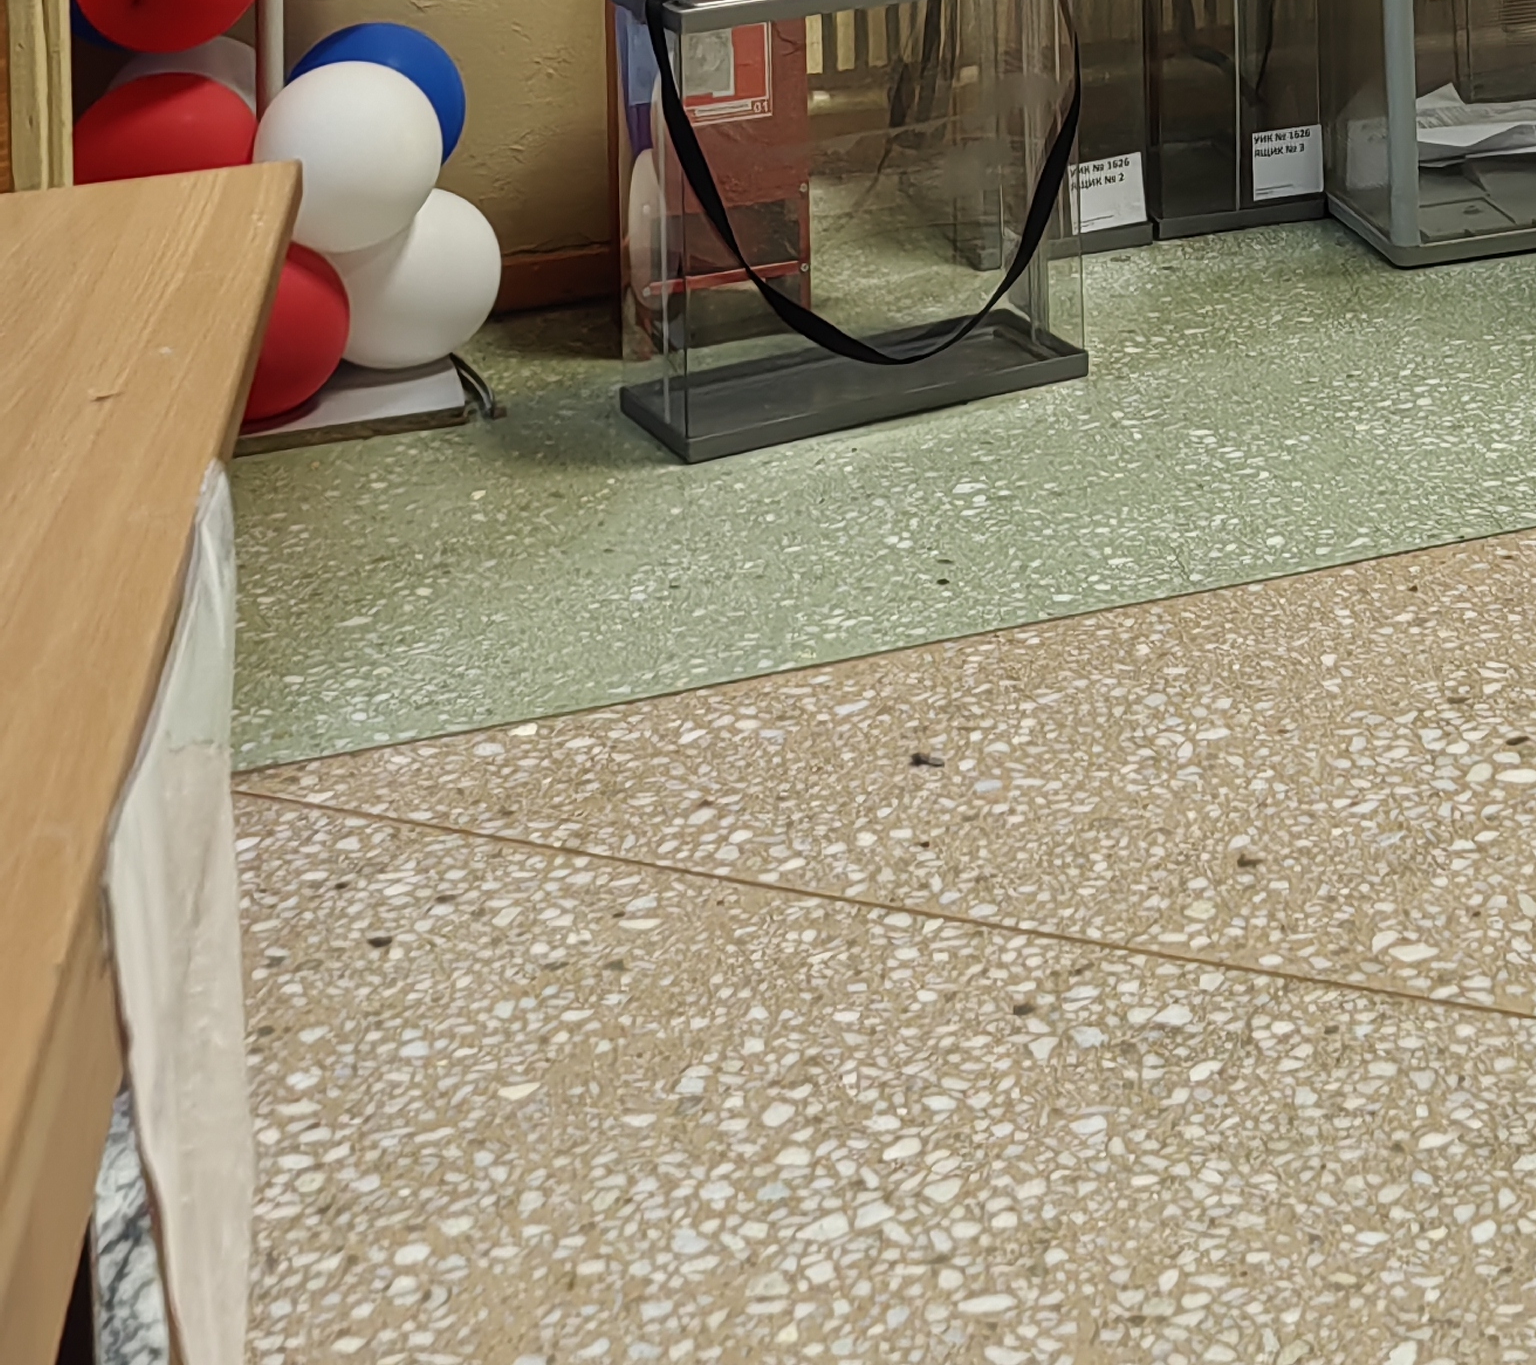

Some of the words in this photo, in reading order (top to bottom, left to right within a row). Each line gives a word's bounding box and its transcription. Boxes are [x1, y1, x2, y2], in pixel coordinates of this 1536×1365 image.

[754, 101, 768, 112] 01
[1254, 134, 1273, 144] УИК
[1255, 146, 1283, 157] ЯЩИК
[1299, 143, 1304, 152] 3
[1093, 164, 1104, 172] №
[1105, 175, 1116, 184] №
[1119, 173, 1124, 182] 2
